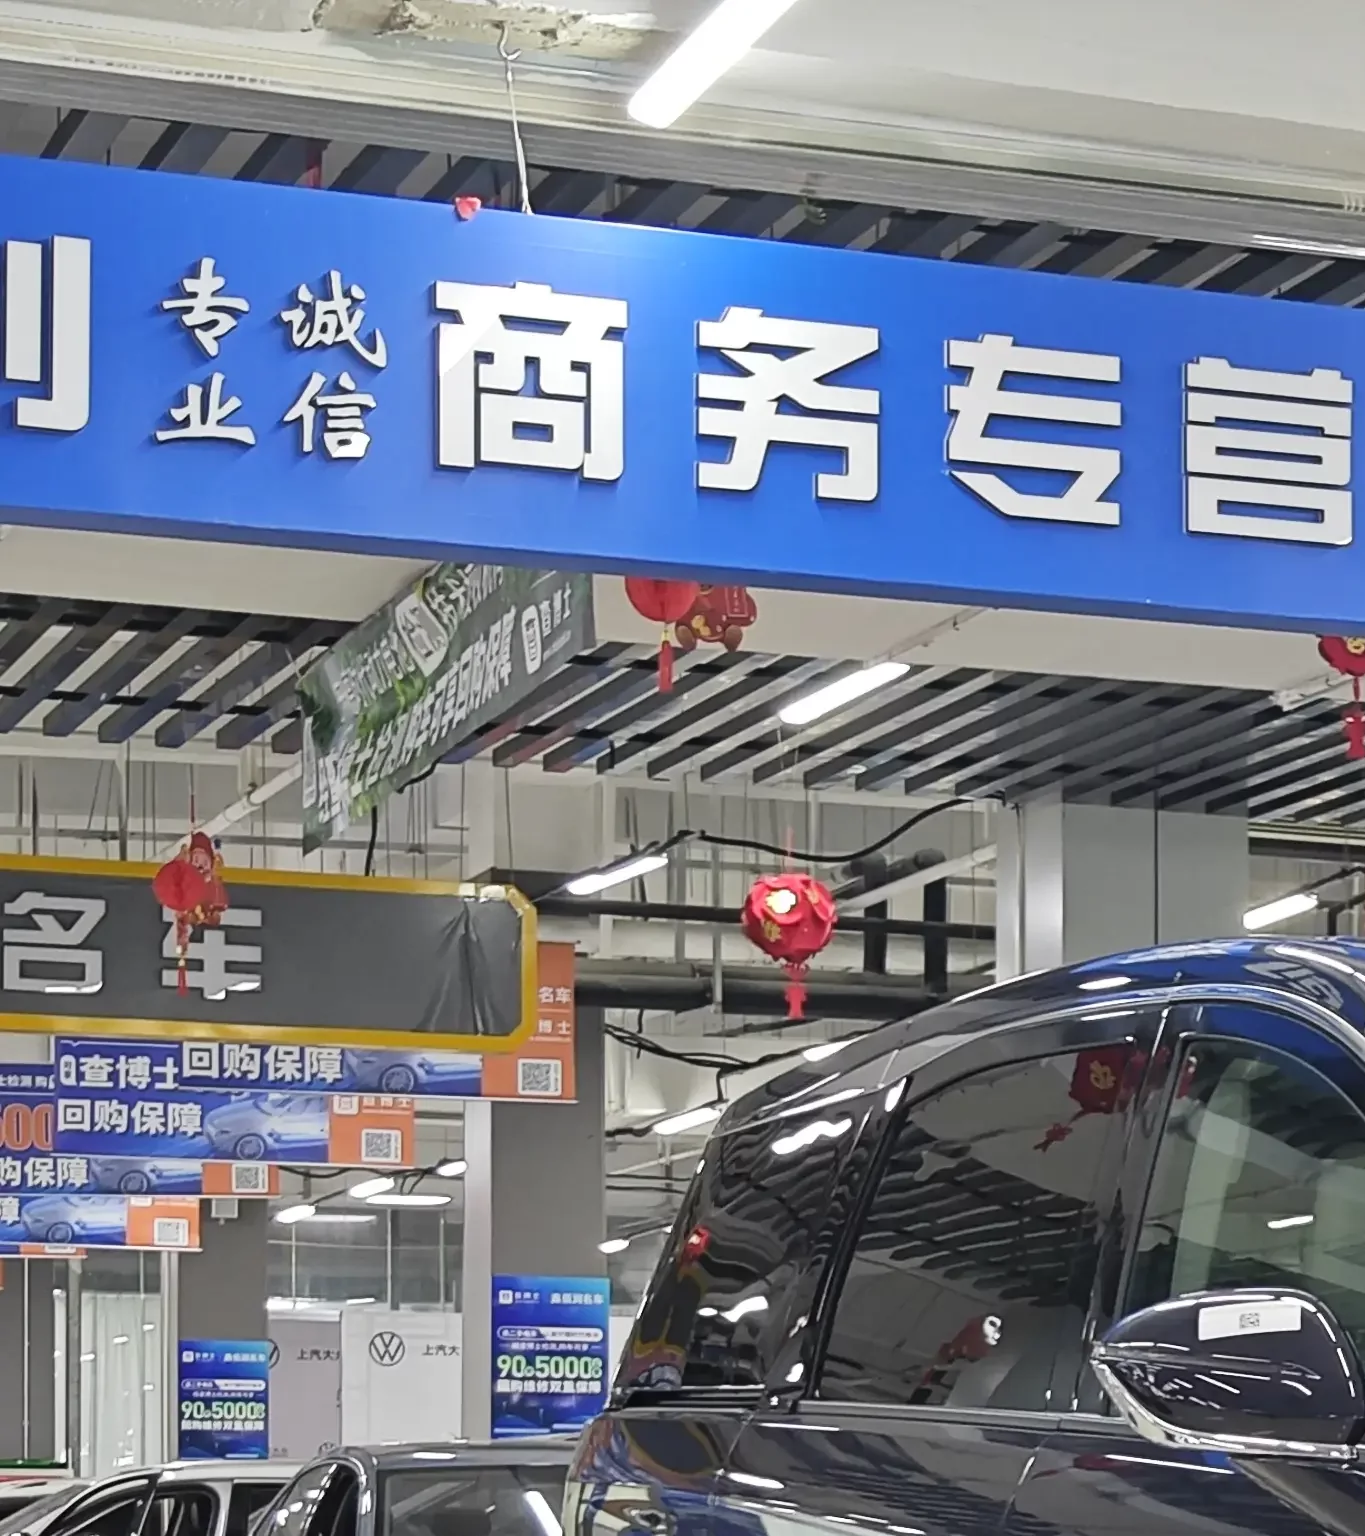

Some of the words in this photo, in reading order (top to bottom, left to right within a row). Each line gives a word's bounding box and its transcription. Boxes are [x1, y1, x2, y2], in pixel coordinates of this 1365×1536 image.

[433, 281, 1354, 546] 商务专营
[3, 890, 262, 1000] 名车
[79, 1054, 179, 1090] 查博士
[182, 1042, 343, 1083] 回购保障
[57, 1099, 203, 1136] 回购保障
